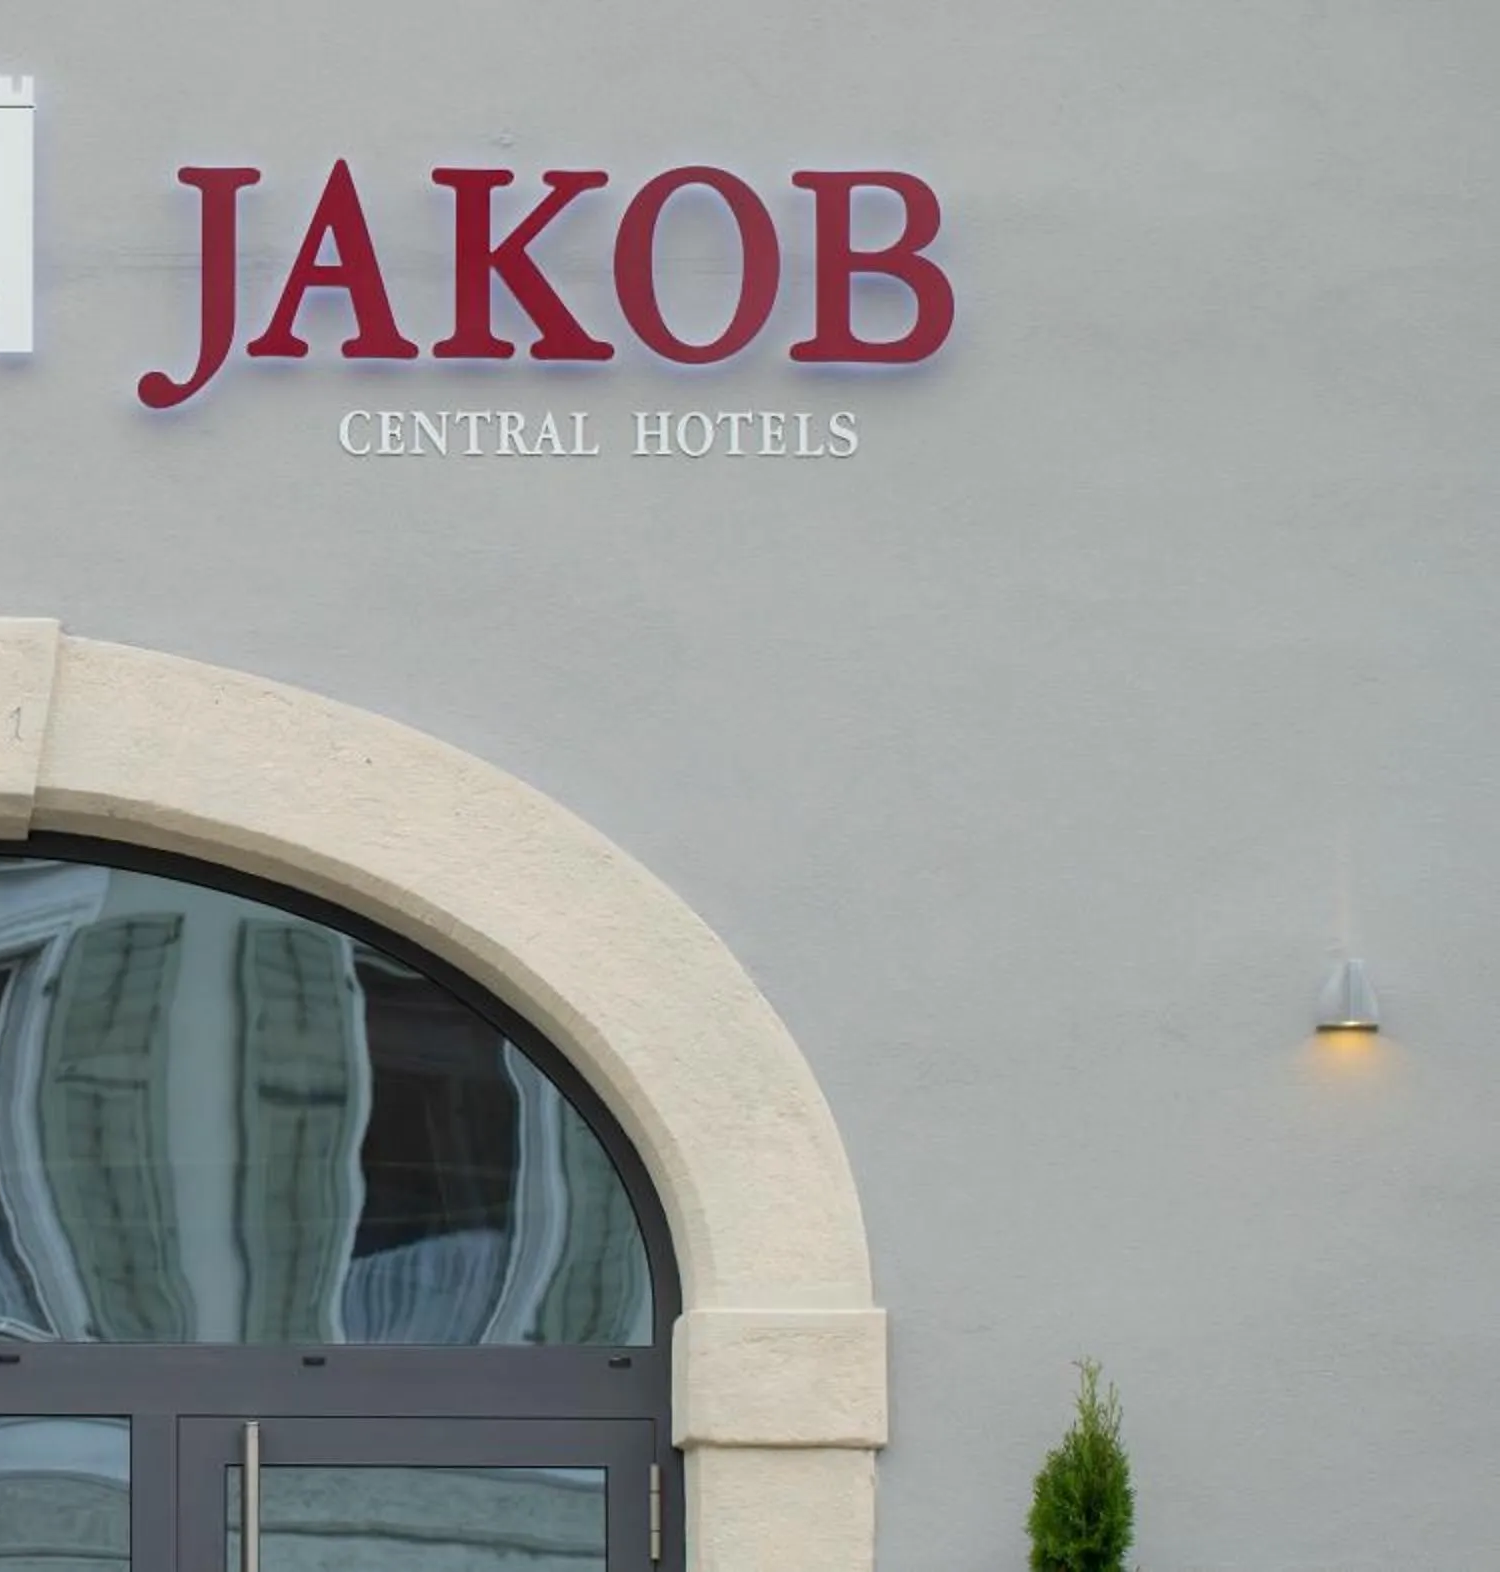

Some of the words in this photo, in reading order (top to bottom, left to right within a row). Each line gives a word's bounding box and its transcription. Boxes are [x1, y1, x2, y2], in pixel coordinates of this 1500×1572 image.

[137, 157, 956, 409] JAKOB
[338, 409, 600, 458] CENTRAL
[632, 410, 860, 459] HOTELS
